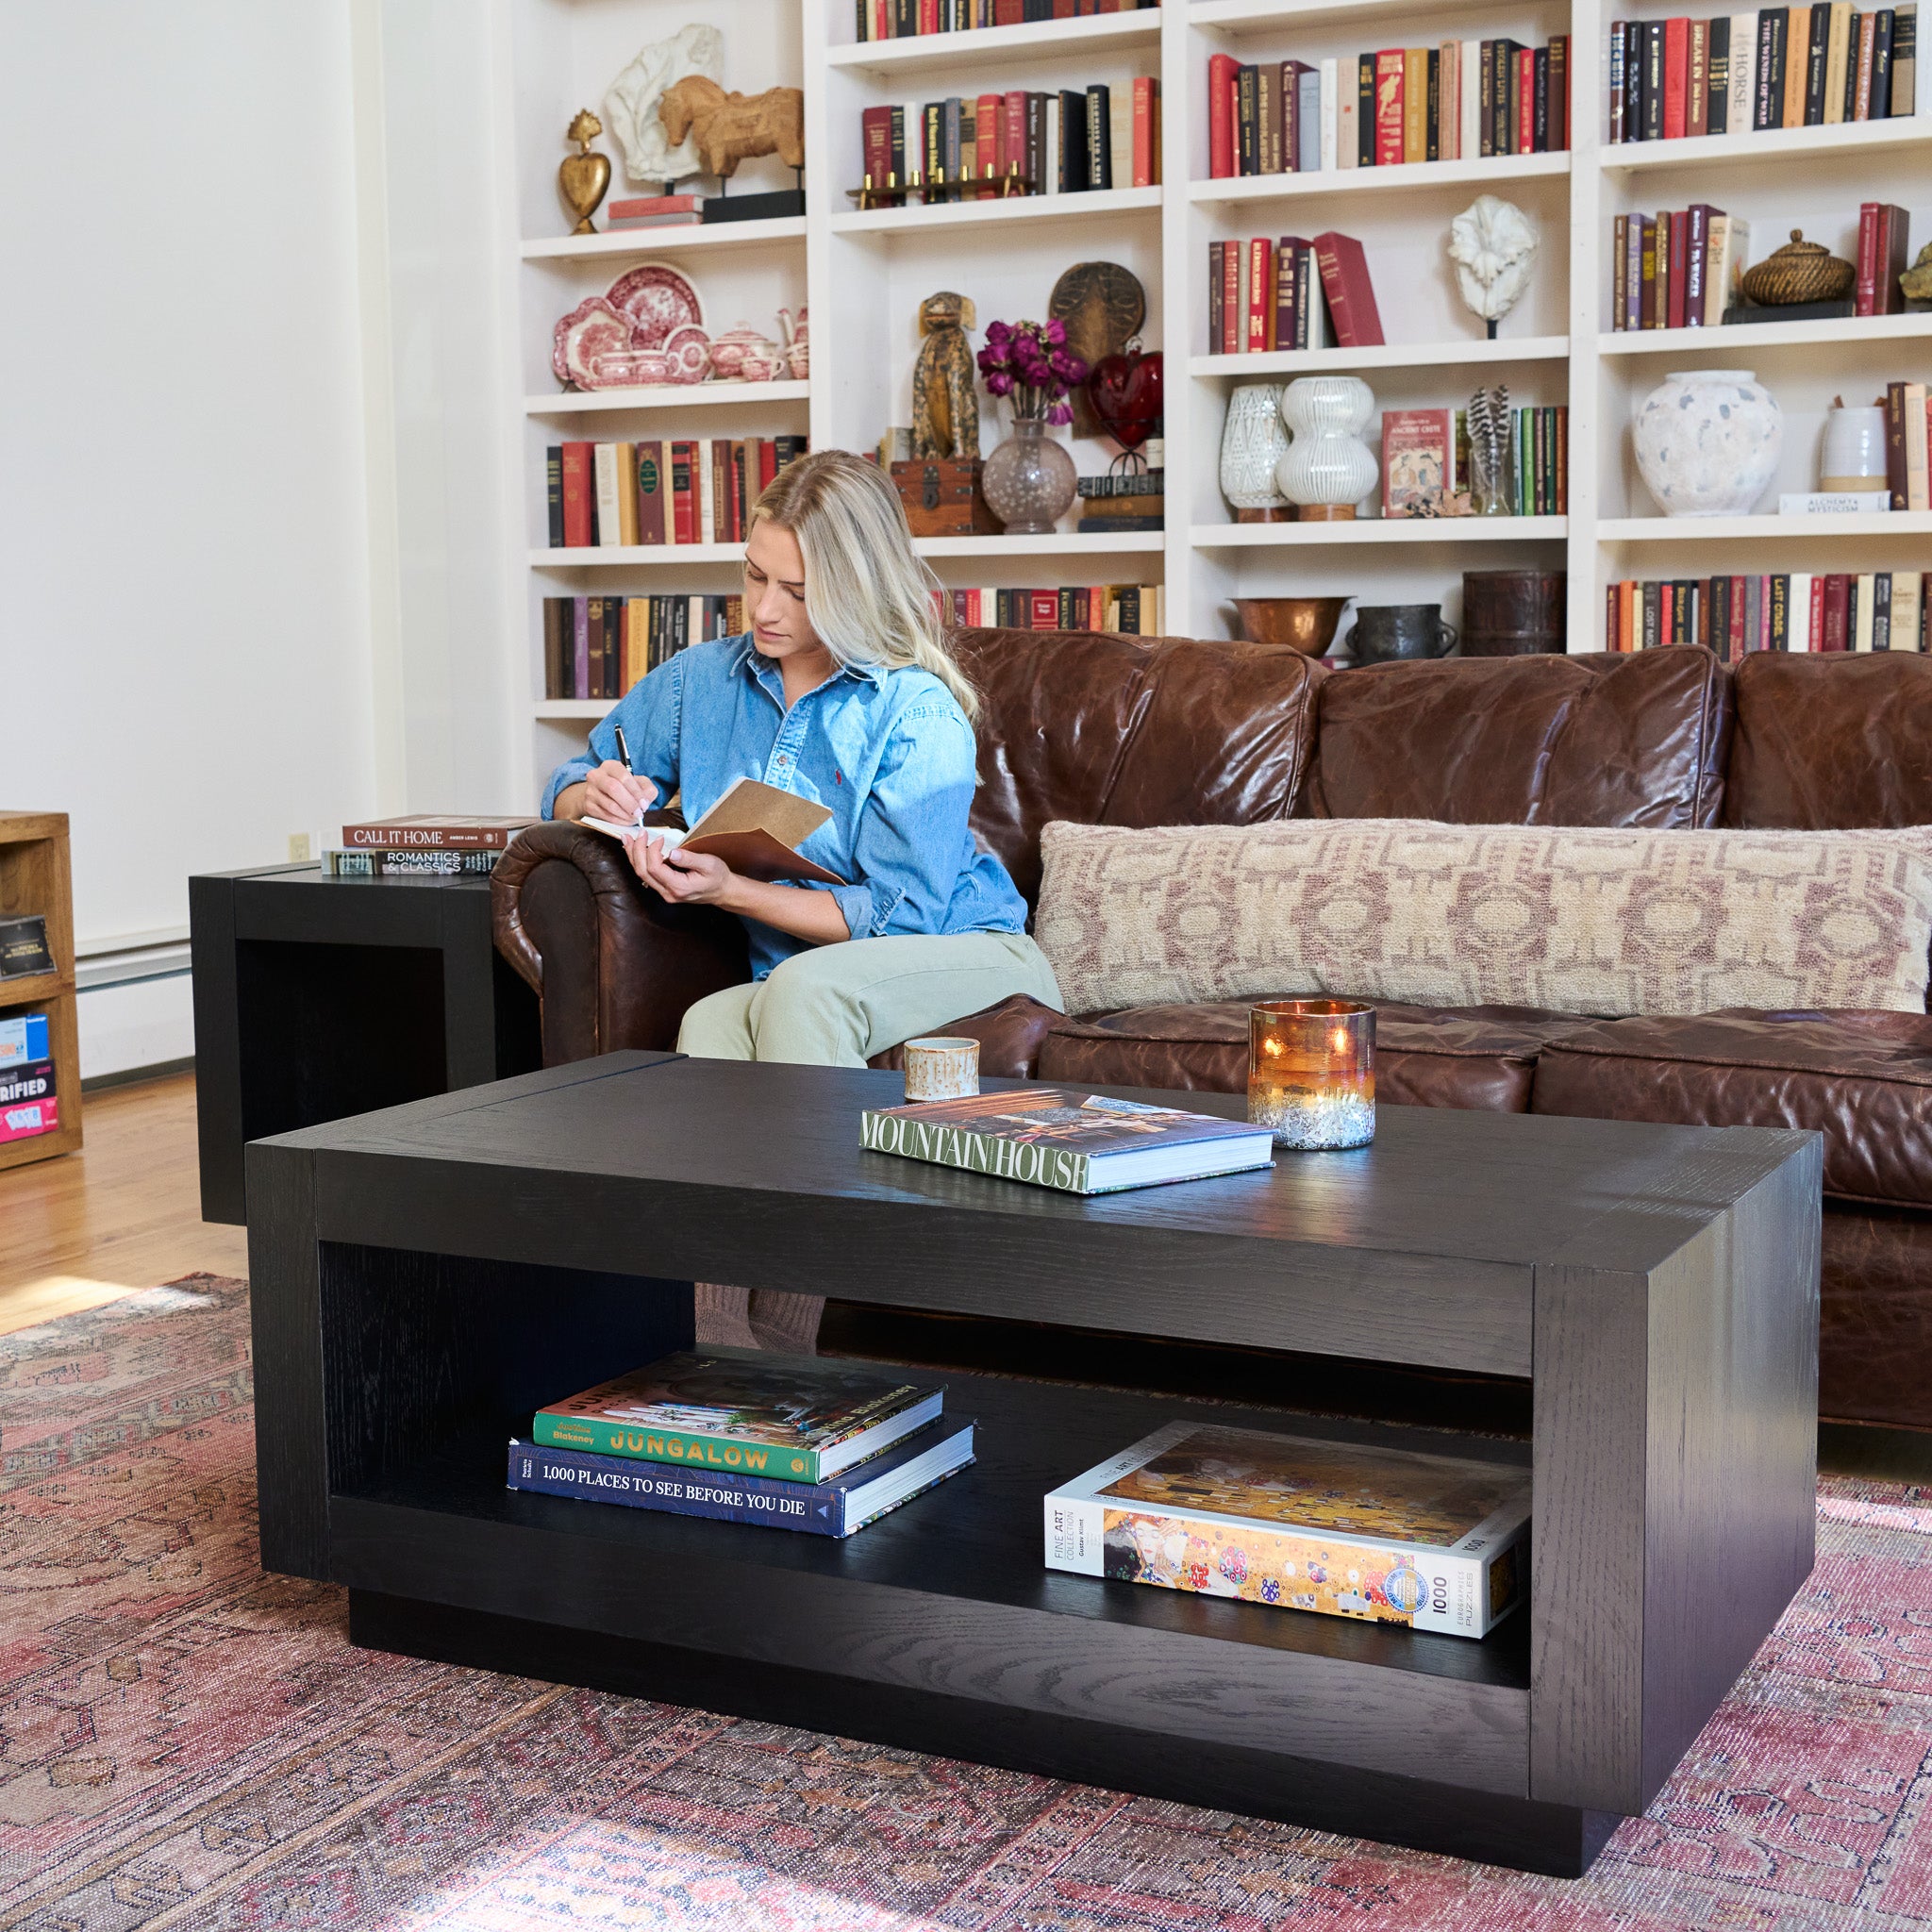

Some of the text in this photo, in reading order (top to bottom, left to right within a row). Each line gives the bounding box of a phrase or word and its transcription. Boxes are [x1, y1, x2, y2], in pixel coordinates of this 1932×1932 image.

[1693, 25, 1703, 63] BREAK
[1693, 66, 1702, 79] IN
[1734, 54, 1748, 109] HORSE
[1758, 19, 1772, 125] THE WINDS OF WAR
[1774, 577, 1784, 637] LAST CITADEL
[1646, 607, 1655, 649] LOST MOO
[354, 829, 388, 843] CALL
[390, 830, 402, 843] IT
[404, 830, 443, 845] HOME
[387, 852, 461, 862] ROMANTICS
[388, 862, 461, 872] & CLASSICS
[858, 1110, 992, 1173] MOUNTAIN
[992, 1135, 1091, 1193] HOUSE
[850, 1384, 920, 1416] Blakeney
[553, 1431, 594, 1445] Blakeney
[610, 1431, 769, 1471] JUNGALOW
[542, 1465, 806, 1516] 1,000 PLACES TO SEE BEFORE YOU DIE
[1054, 1509, 1064, 1559] FINE ART
[1066, 1511, 1074, 1561] COLLECTION
[1387, 1573, 1398, 1605] MUSEUM
[1416, 1575, 1428, 1607] QUALITY
[1432, 1576, 1447, 1614] 1000
[1457, 1570, 1465, 1625] EUROGRAPHICS
[1465, 1573, 1474, 1626] PUZZLES
